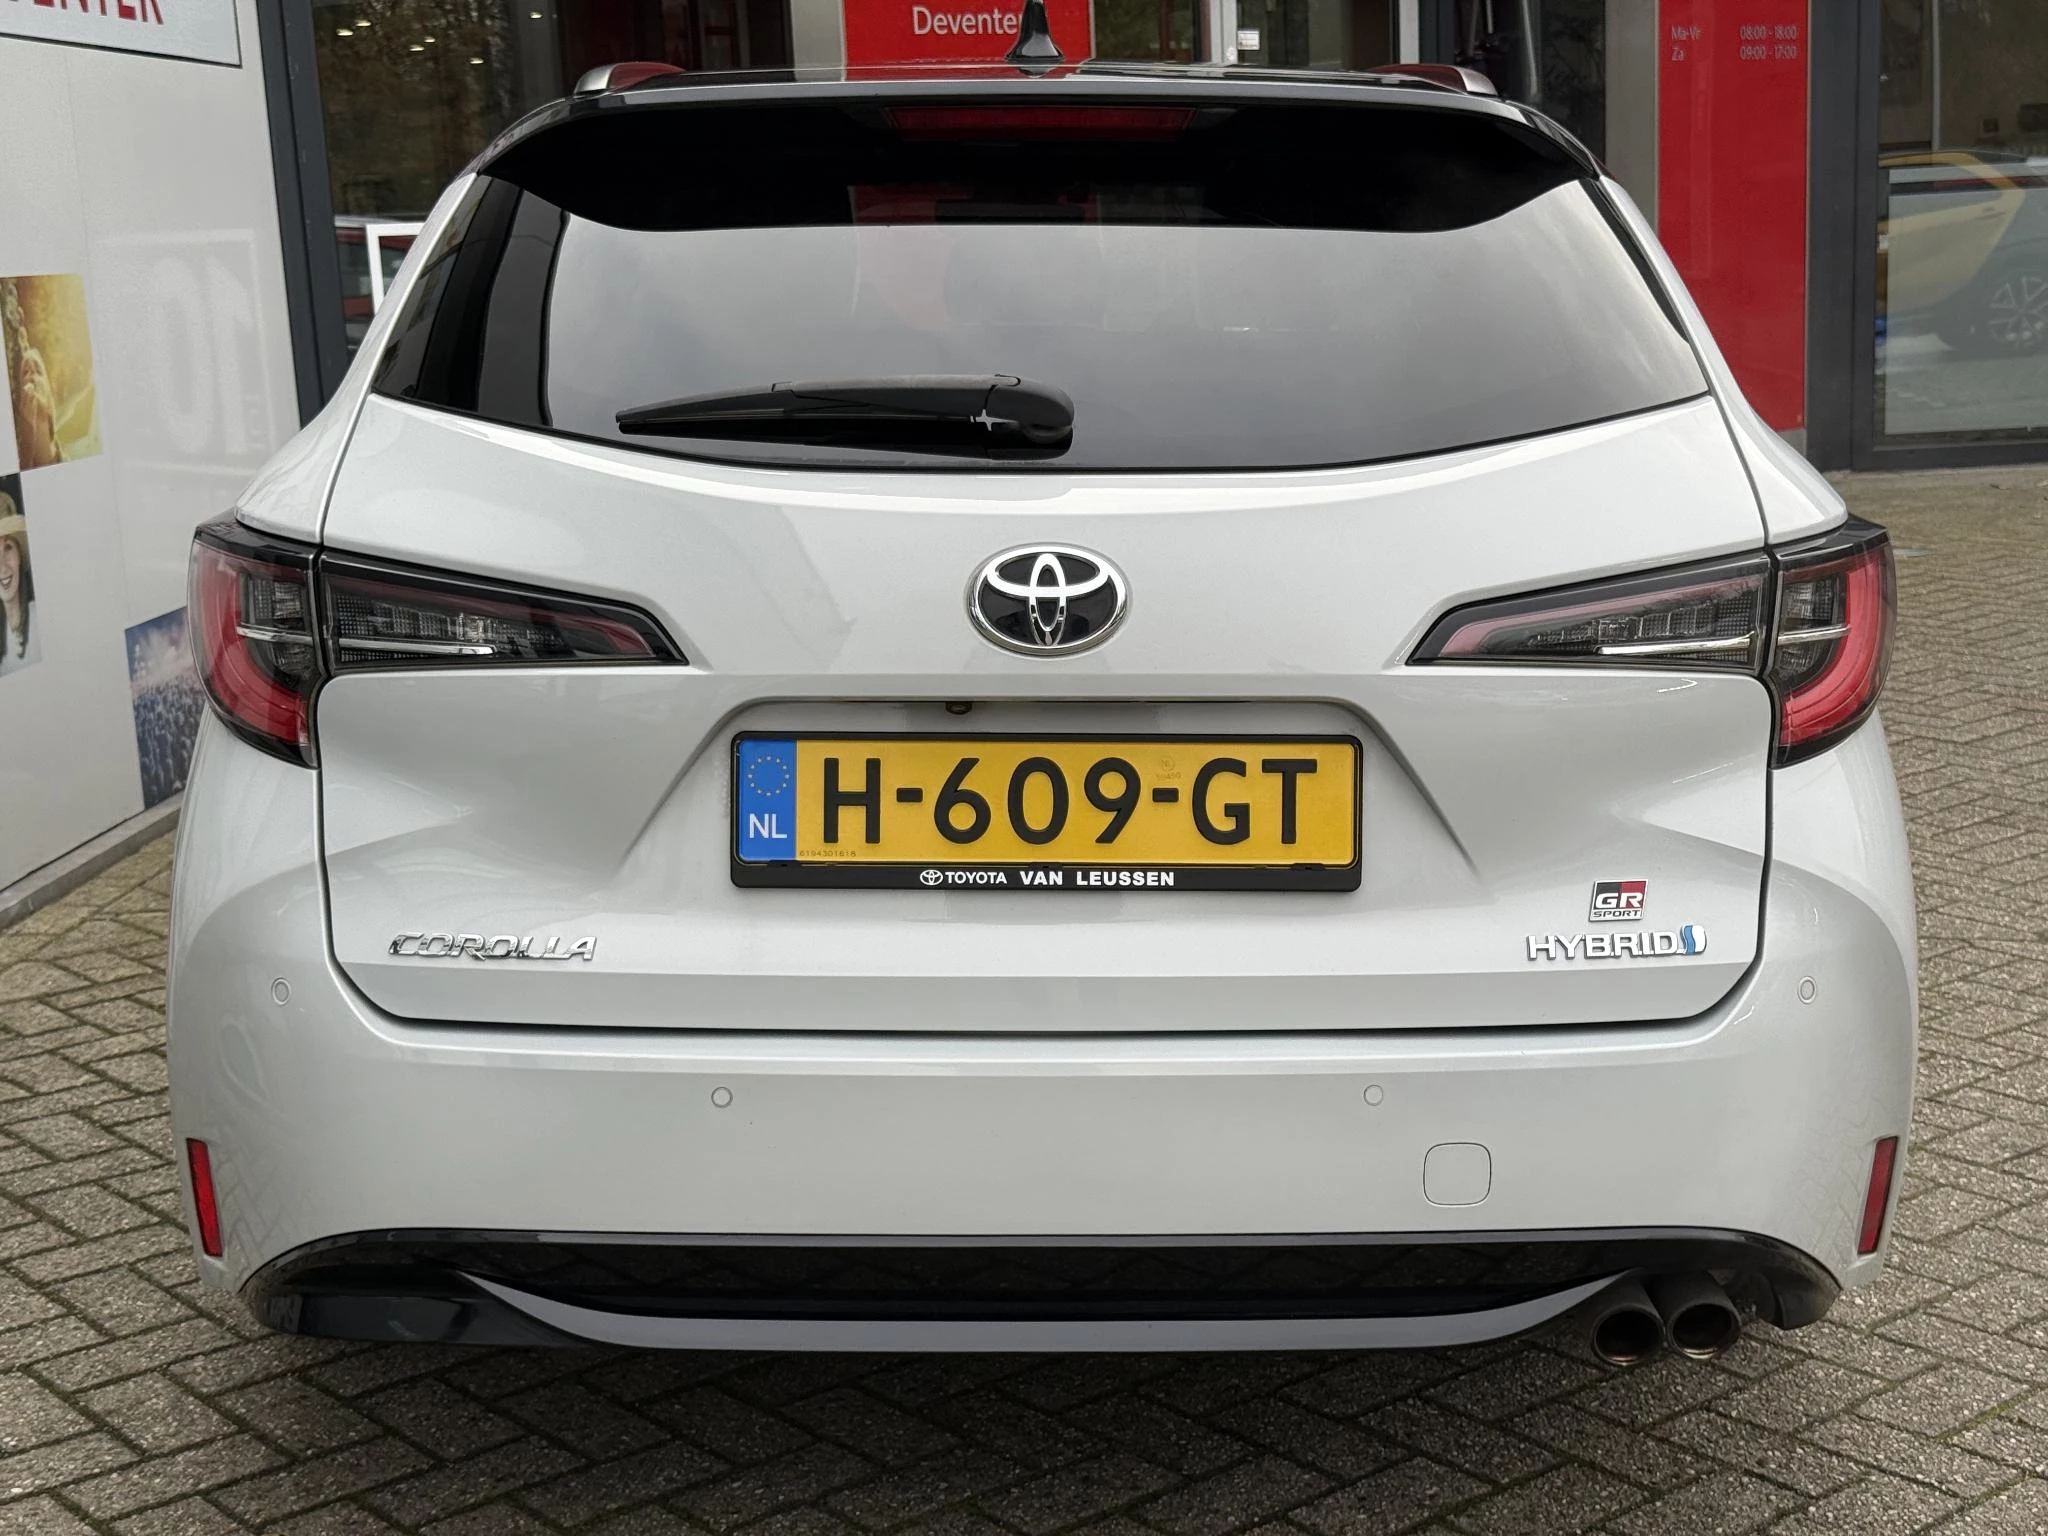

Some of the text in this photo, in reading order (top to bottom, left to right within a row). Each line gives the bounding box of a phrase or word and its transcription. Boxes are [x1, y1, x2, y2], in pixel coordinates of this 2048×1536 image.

[912, 5, 1022, 35] Devente
[1740, 25, 1767, 41] 08:00
[1774, 25, 1798, 41] 18:00
[1671, 47, 1685, 62] Za
[1740, 46, 1767, 61] 09:00
[1774, 46, 1798, 61] 17:00
[823, 756, 1318, 845] H-609-GT
[750, 813, 788, 839] NL
[944, 871, 1175, 887] TOYOTA VAN LEUSSEN
[1595, 892, 1644, 909] GR
[1592, 910, 1641, 918] SPORT
[388, 932, 598, 962] COROLLA
[1526, 931, 1679, 961] HYBRID
